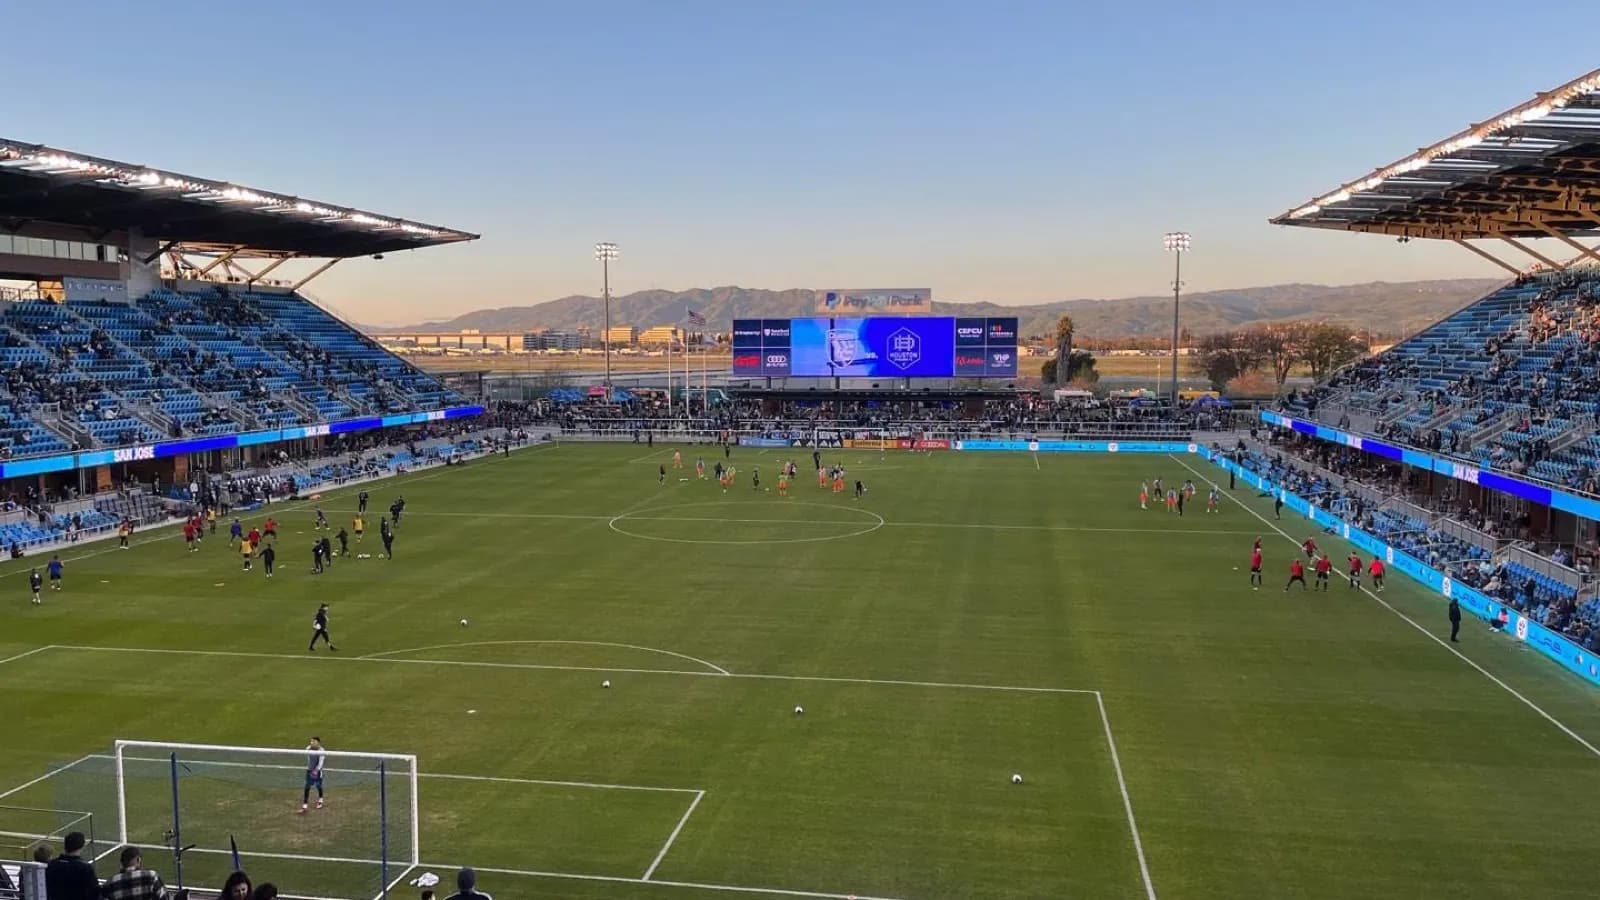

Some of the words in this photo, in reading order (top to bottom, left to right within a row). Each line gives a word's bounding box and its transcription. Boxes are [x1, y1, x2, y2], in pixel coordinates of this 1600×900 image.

[890, 293, 923, 307] Park
[114, 449, 133, 462] SAN
[134, 446, 154, 459] JOSE
